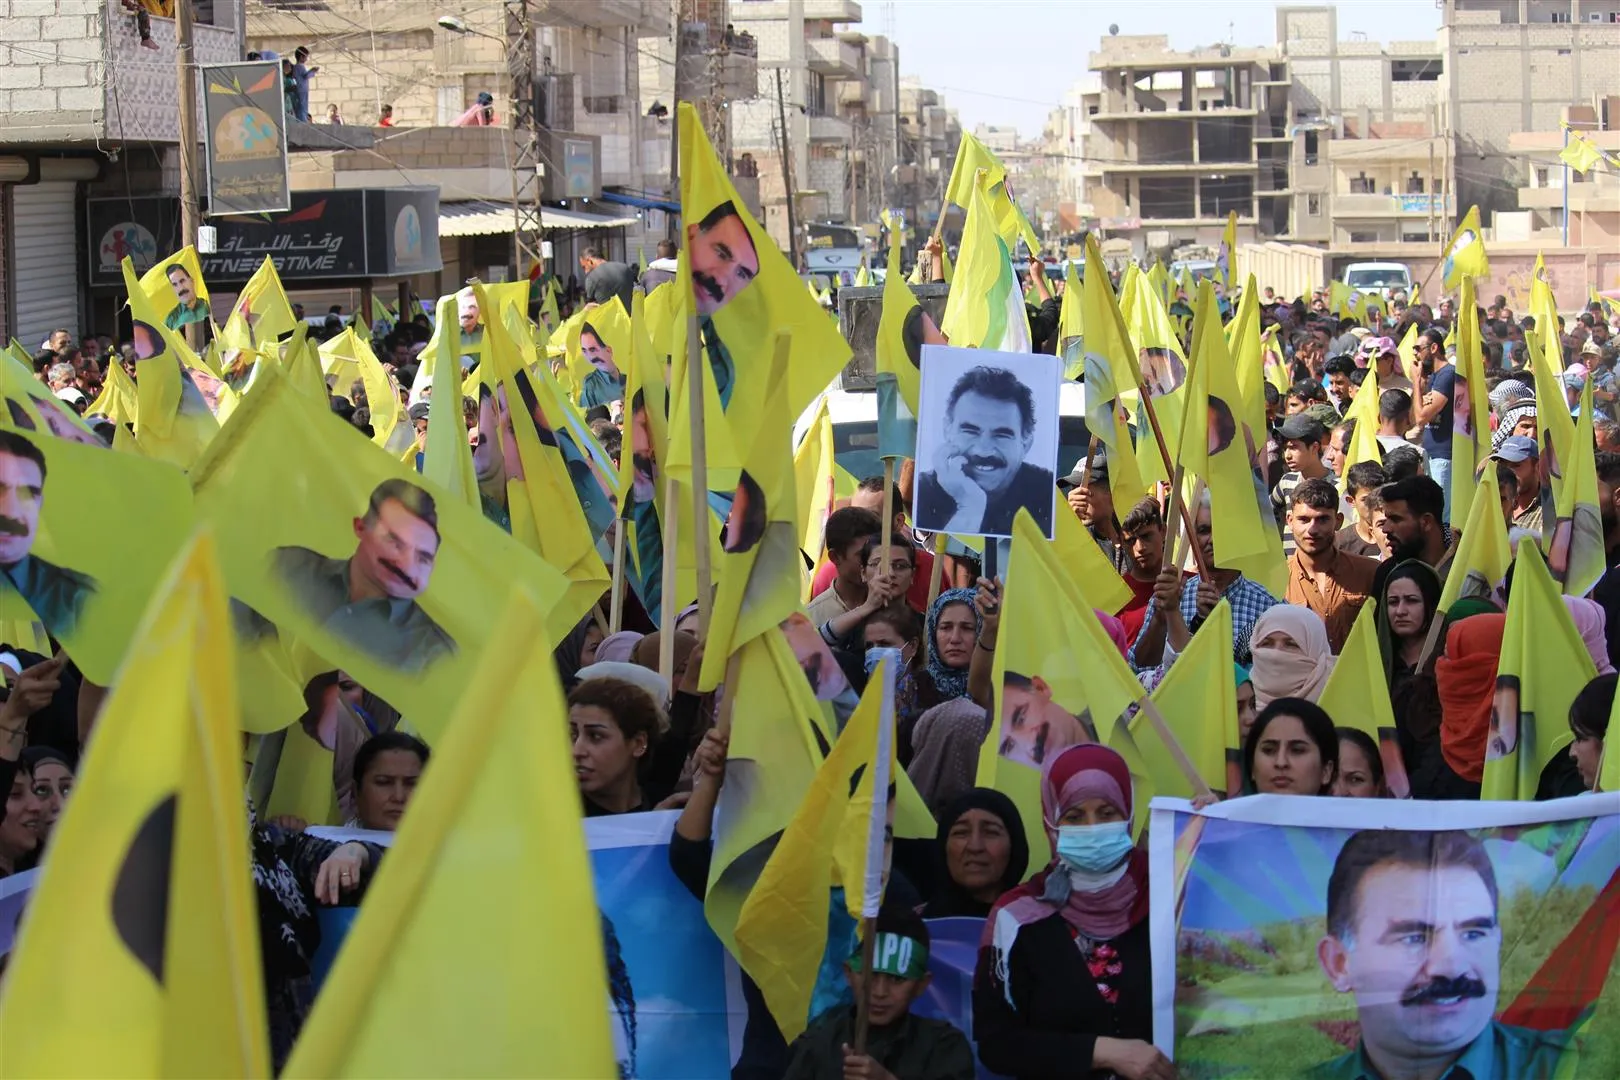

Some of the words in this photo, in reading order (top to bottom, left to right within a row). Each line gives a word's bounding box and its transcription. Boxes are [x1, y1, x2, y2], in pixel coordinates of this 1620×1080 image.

[217, 234, 291, 255] اللياق
[202, 256, 286, 273] ITNESS
[287, 255, 337, 270] TIME
